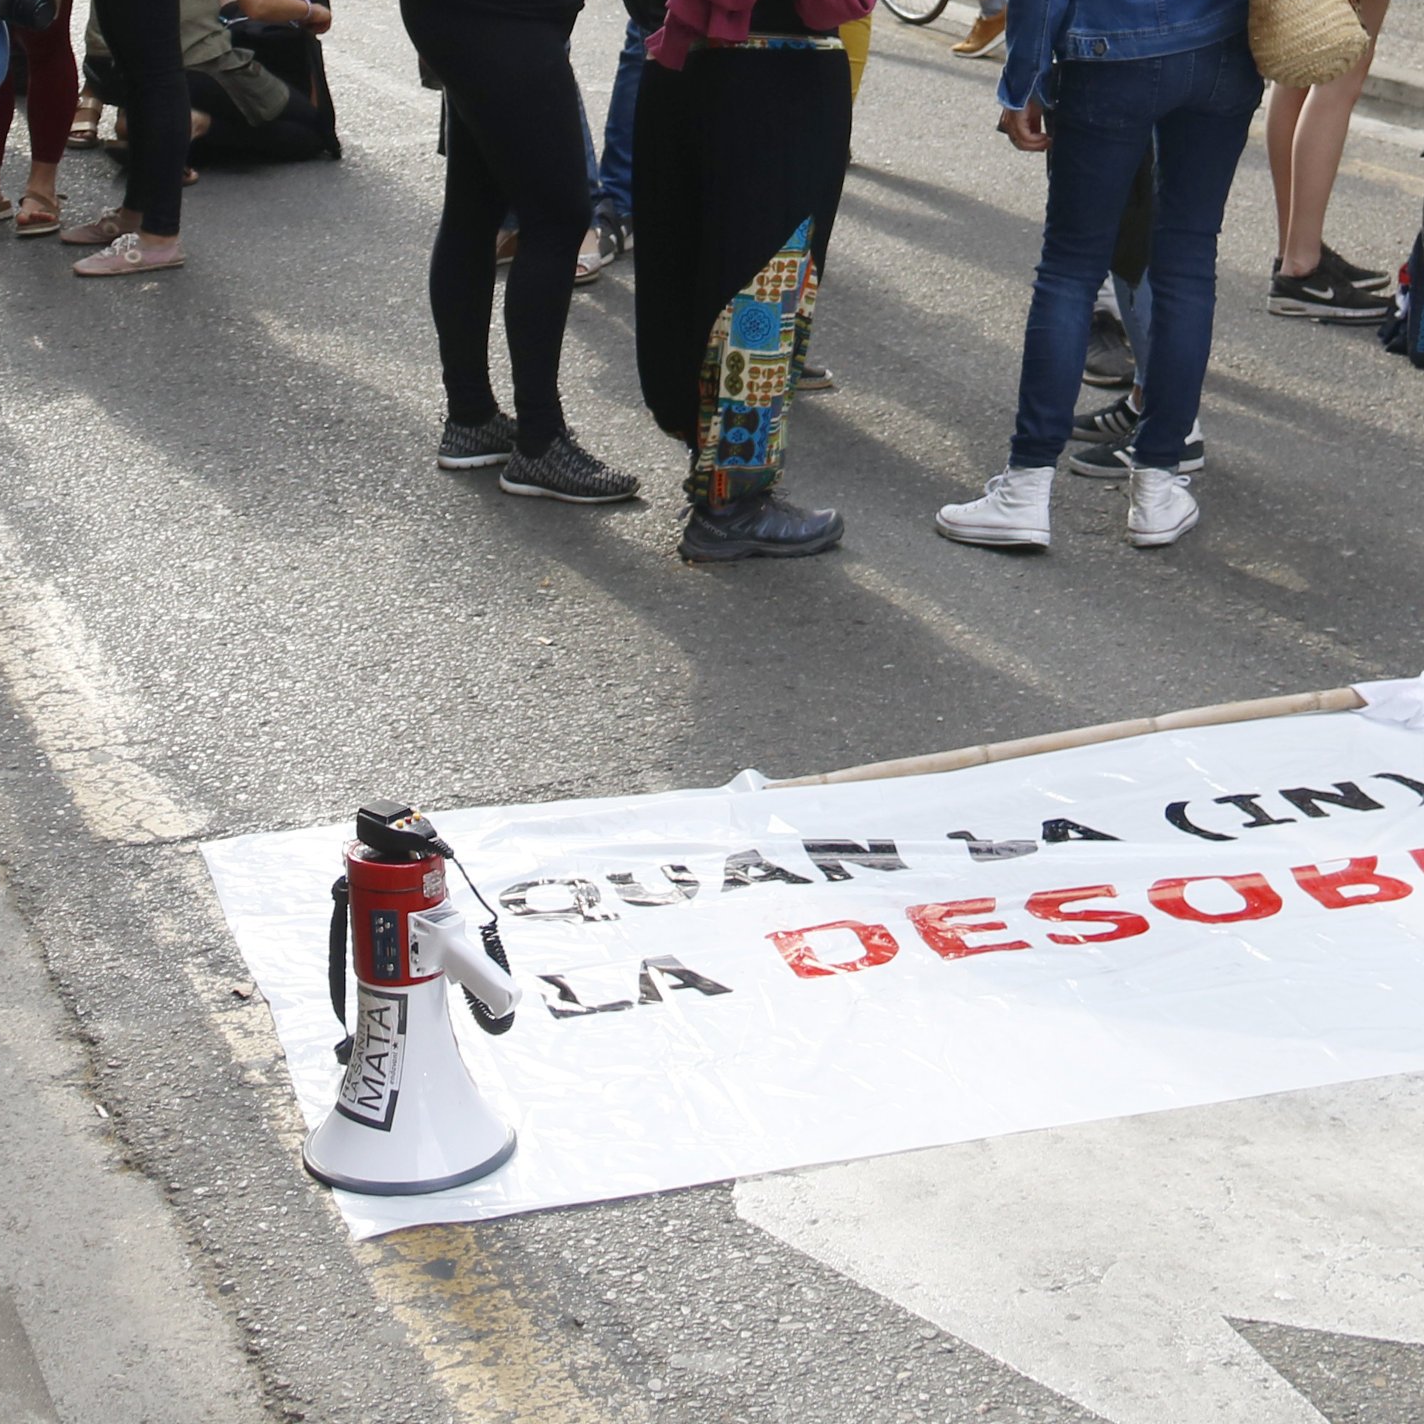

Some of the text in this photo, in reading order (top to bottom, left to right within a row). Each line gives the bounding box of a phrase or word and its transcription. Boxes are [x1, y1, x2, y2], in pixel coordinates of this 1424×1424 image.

[498, 837, 913, 923] QUAN
[539, 953, 734, 1020] LA
[356, 1005, 392, 1112] MATA
